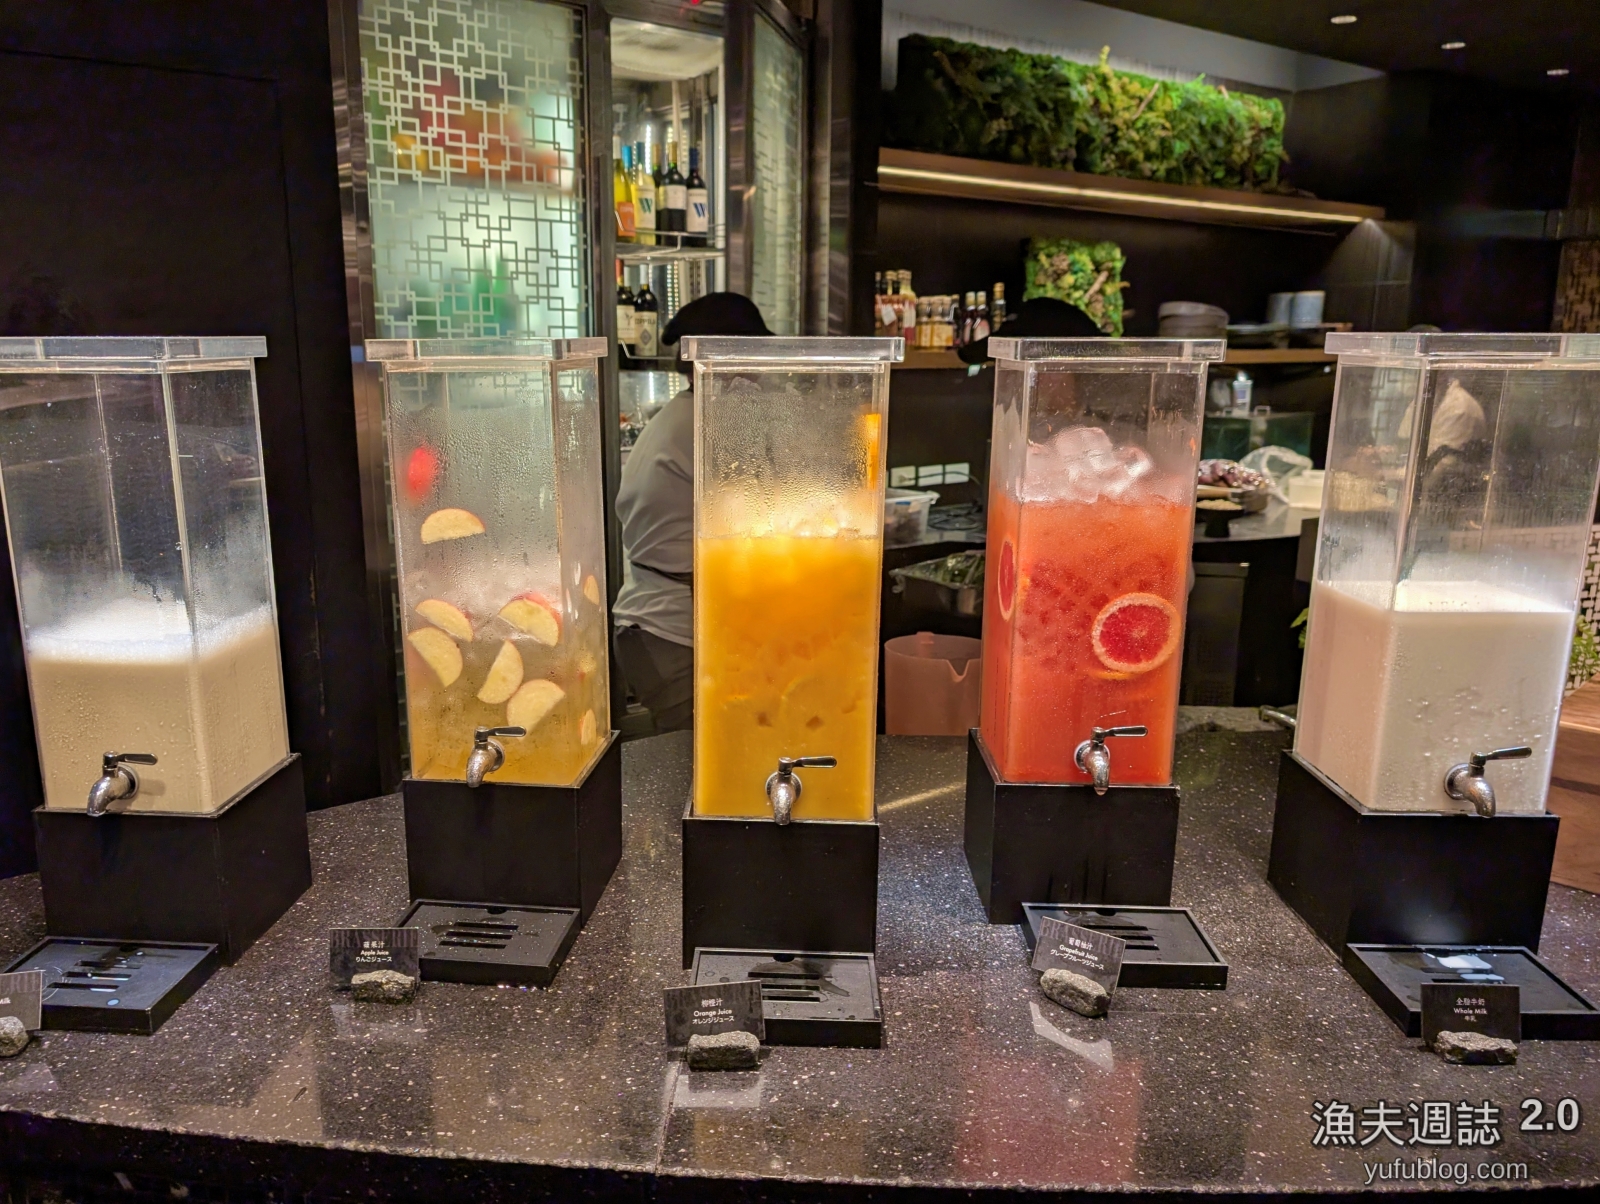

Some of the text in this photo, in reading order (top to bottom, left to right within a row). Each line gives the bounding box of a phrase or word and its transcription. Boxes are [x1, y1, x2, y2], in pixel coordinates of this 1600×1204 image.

[1058, 945, 1098, 960] Grapefruit Juice
[1456, 997, 1485, 1005] 全脂牛奶
[692, 1016, 735, 1025] オレンジジュース
